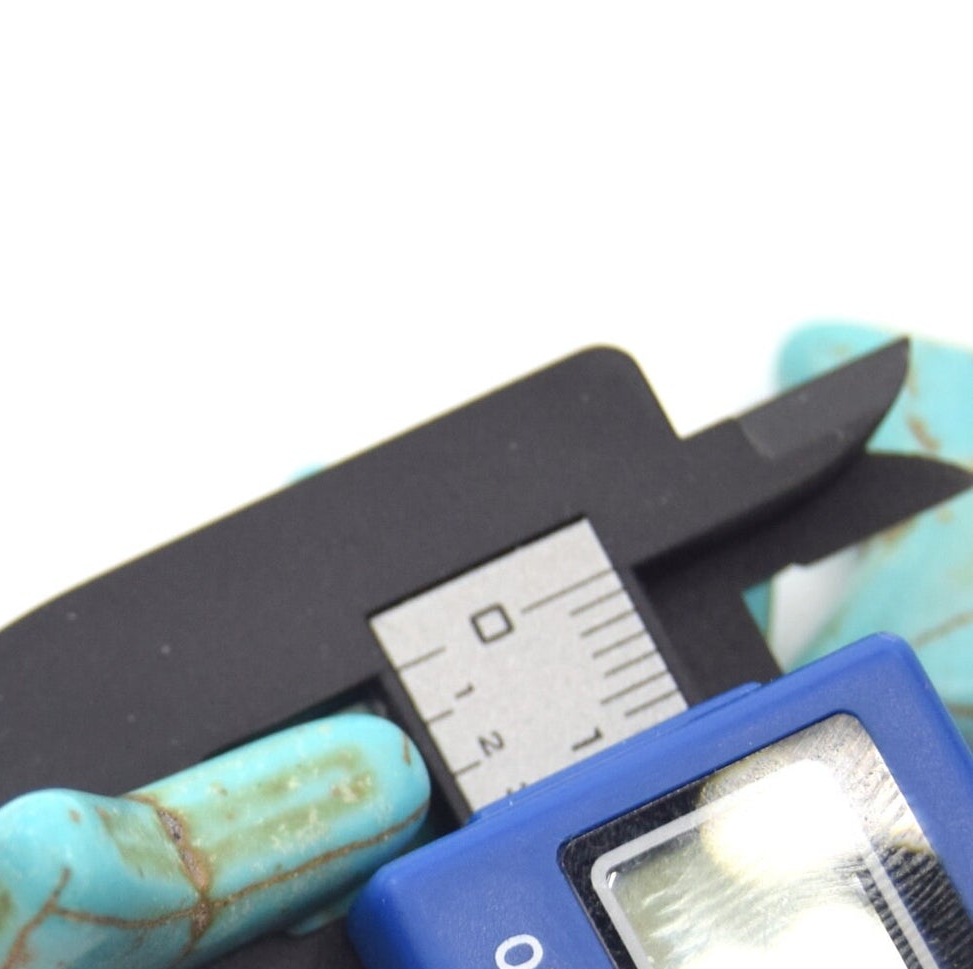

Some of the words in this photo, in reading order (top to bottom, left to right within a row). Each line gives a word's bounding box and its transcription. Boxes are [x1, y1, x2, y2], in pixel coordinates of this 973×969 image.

[454, 682, 475, 700] 1
[478, 730, 505, 757] 2
[571, 726, 603, 753] 1
